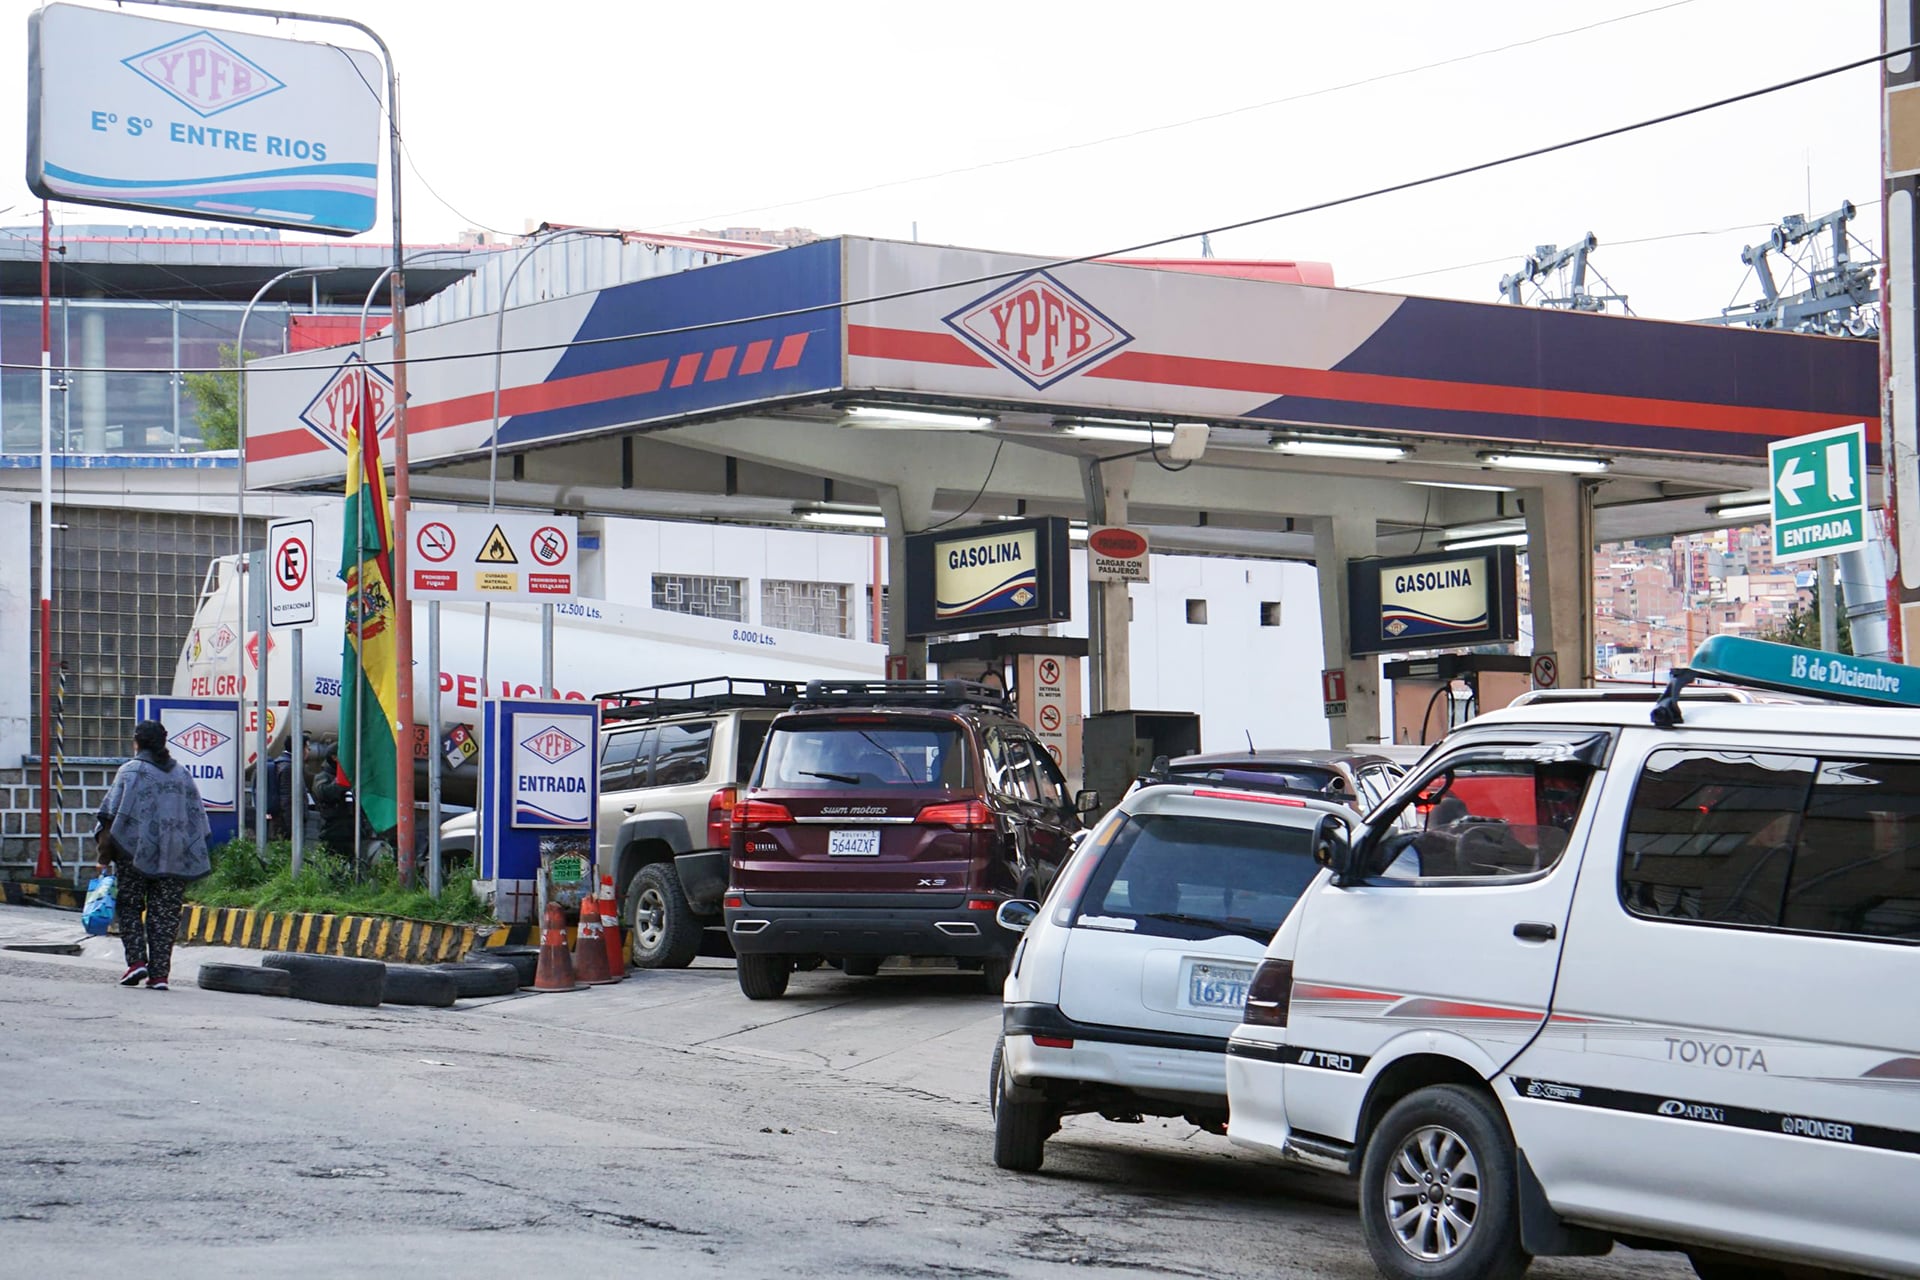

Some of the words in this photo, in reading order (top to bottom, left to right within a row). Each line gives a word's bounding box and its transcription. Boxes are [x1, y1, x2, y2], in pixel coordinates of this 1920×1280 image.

[157, 48, 253, 101] YPFB
[170, 122, 257, 153] ENTRE
[267, 135, 327, 161] RIOS
[990, 287, 1092, 371] YPFB
[325, 369, 385, 439] YPB
[1783, 518, 1854, 548] ENTRADA
[949, 541, 1022, 570] GASOLINA
[1096, 559, 1126, 567] CARGAR
[1098, 566, 1140, 575] PASAJEROS
[1395, 568, 1472, 594] GASOLINA
[282, 601, 311, 611] ESTACIONAR
[556, 603, 584, 616] 12.500
[587, 606, 602, 619] Lts.
[732, 629, 758, 644] 8.000
[759, 632, 776, 646] Lts.
[1791, 654, 1806, 679] 18
[1808, 658, 1827, 682] de
[1829, 659, 1901, 694] Diciembre
[182, 730, 218, 750] YPFB
[534, 733, 572, 757] YPFB
[519, 775, 586, 793] ENTRADA
[850, 805, 888, 814] motors
[832, 838, 876, 854] 5644ZXF
[1314, 1051, 1353, 1071] TRD
[1664, 1037, 1768, 1073] TOYOTA
[1793, 1117, 1853, 1142] PIONEER
